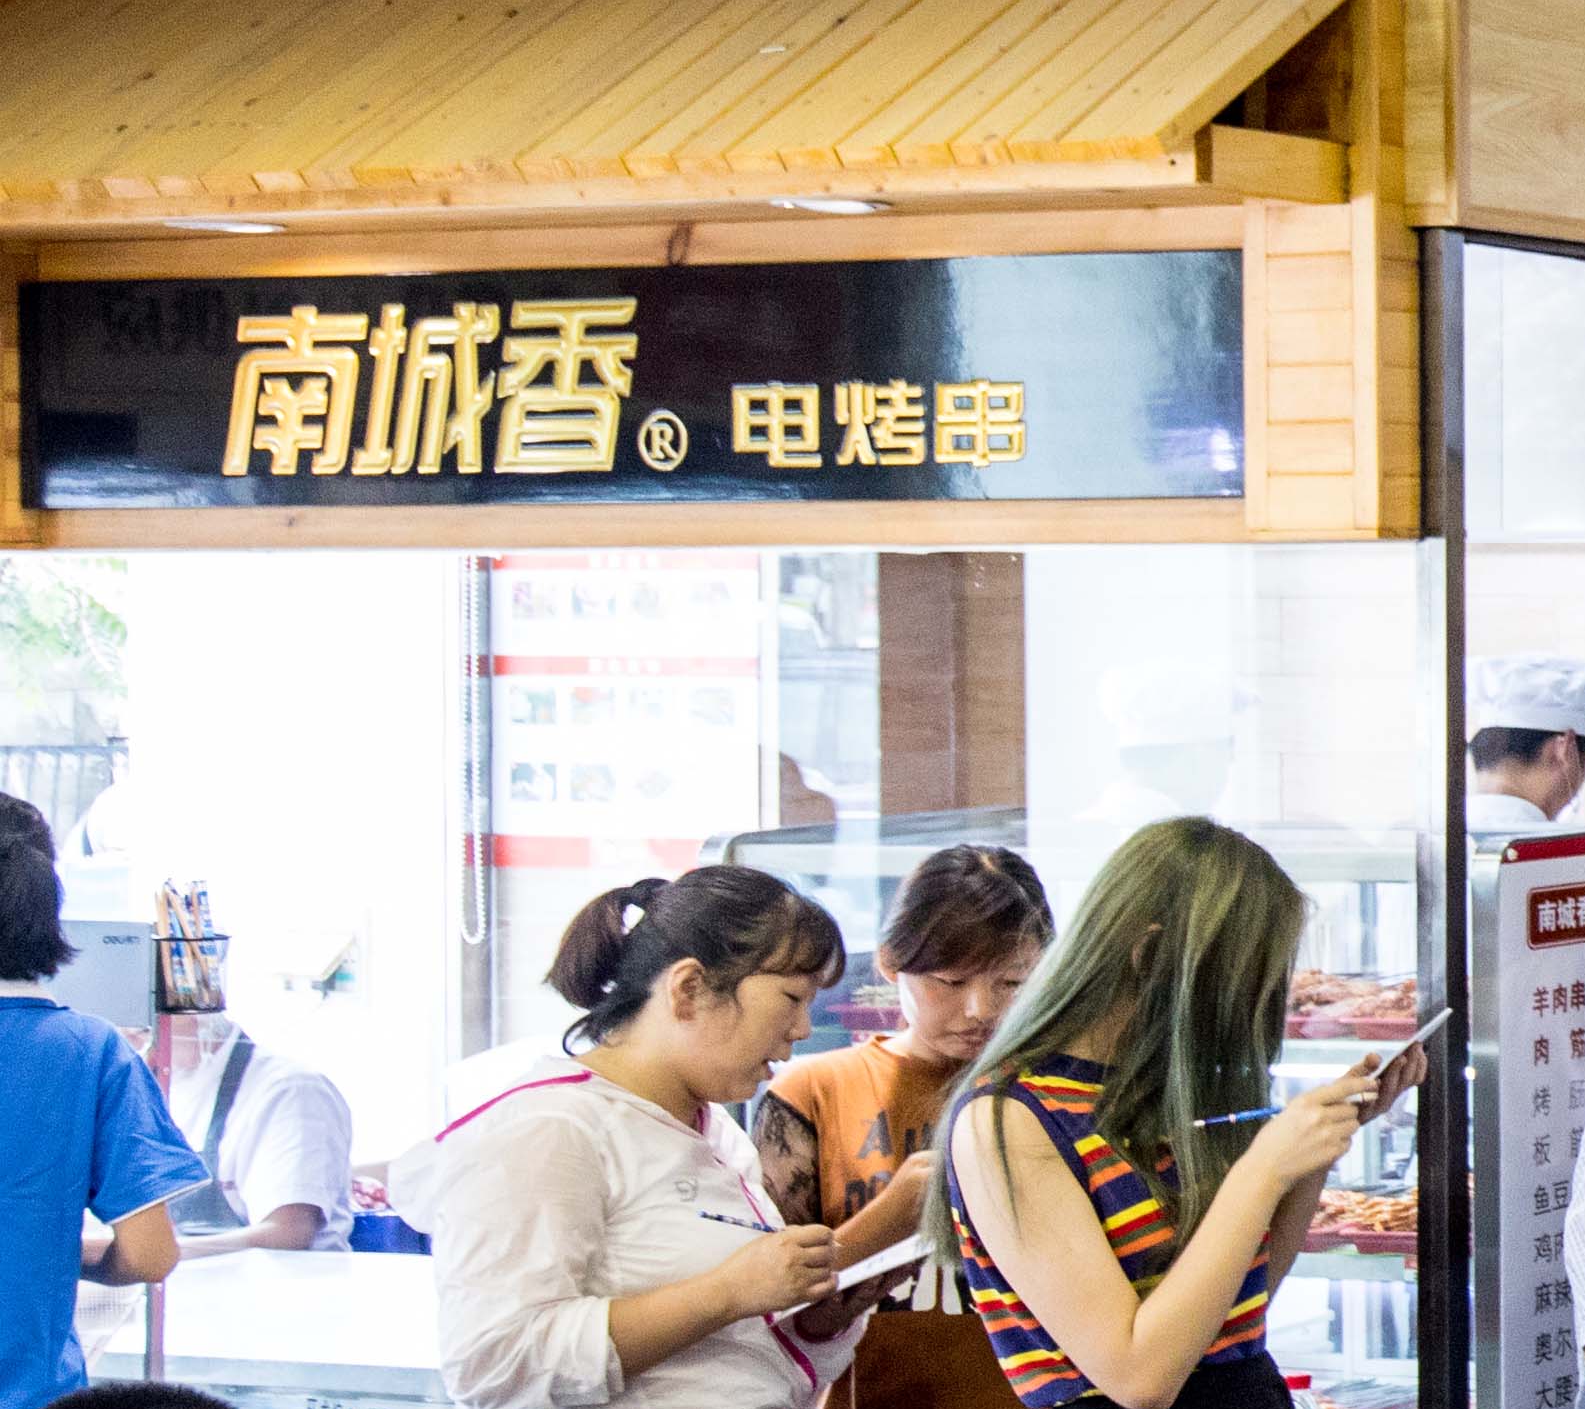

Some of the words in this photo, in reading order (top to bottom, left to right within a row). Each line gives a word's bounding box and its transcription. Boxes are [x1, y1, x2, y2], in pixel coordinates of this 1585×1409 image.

[221, 296, 639, 476] 南城香
[730, 378, 1028, 469] 电烤串
